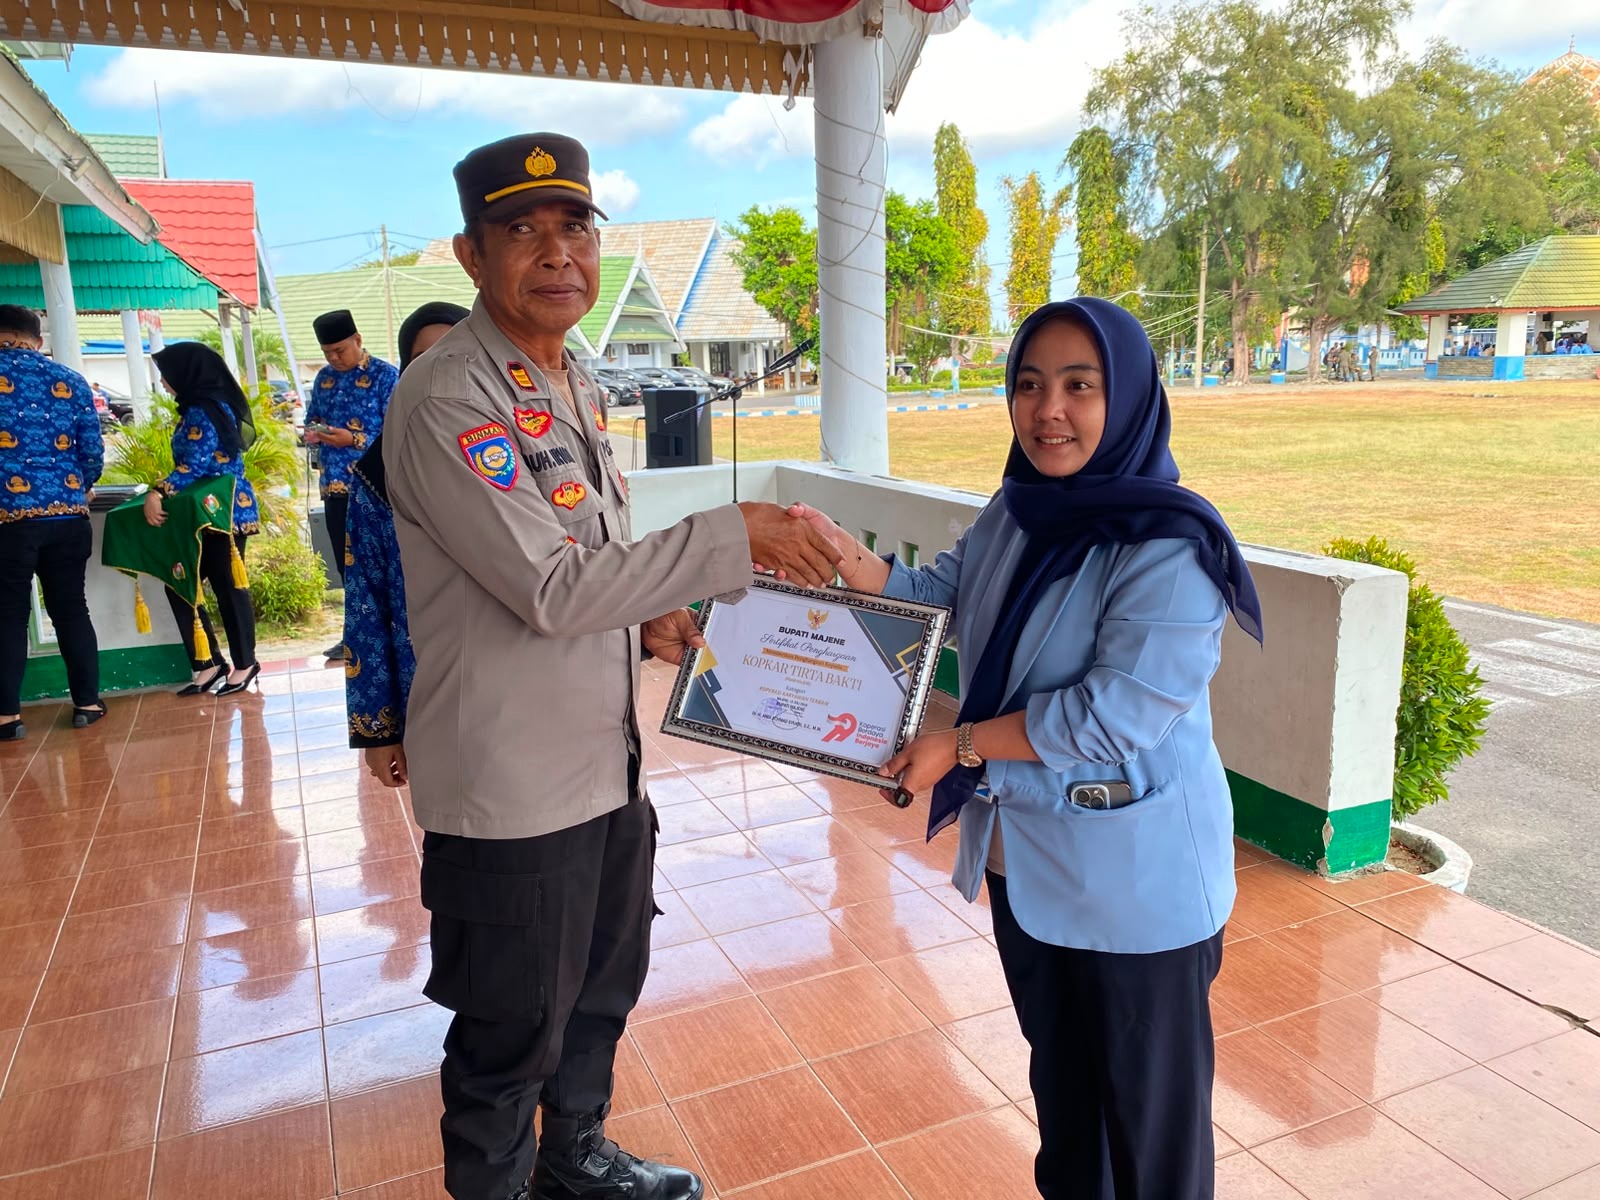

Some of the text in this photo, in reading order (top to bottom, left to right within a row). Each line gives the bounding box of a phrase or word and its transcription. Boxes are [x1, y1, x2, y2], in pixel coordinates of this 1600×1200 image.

[778, 626, 846, 646] BUPATI MAJENE
[760, 633, 857, 662] Sertifikat Penghargaan
[743, 654, 788, 674] KOPKAR
[790, 664, 823, 683] TIRTA
[825, 671, 862, 691] BAKTI
[859, 722, 886, 732] Koperasi
[855, 738, 880, 749] Berjaya
[856, 733, 888, 744] Indonesia
